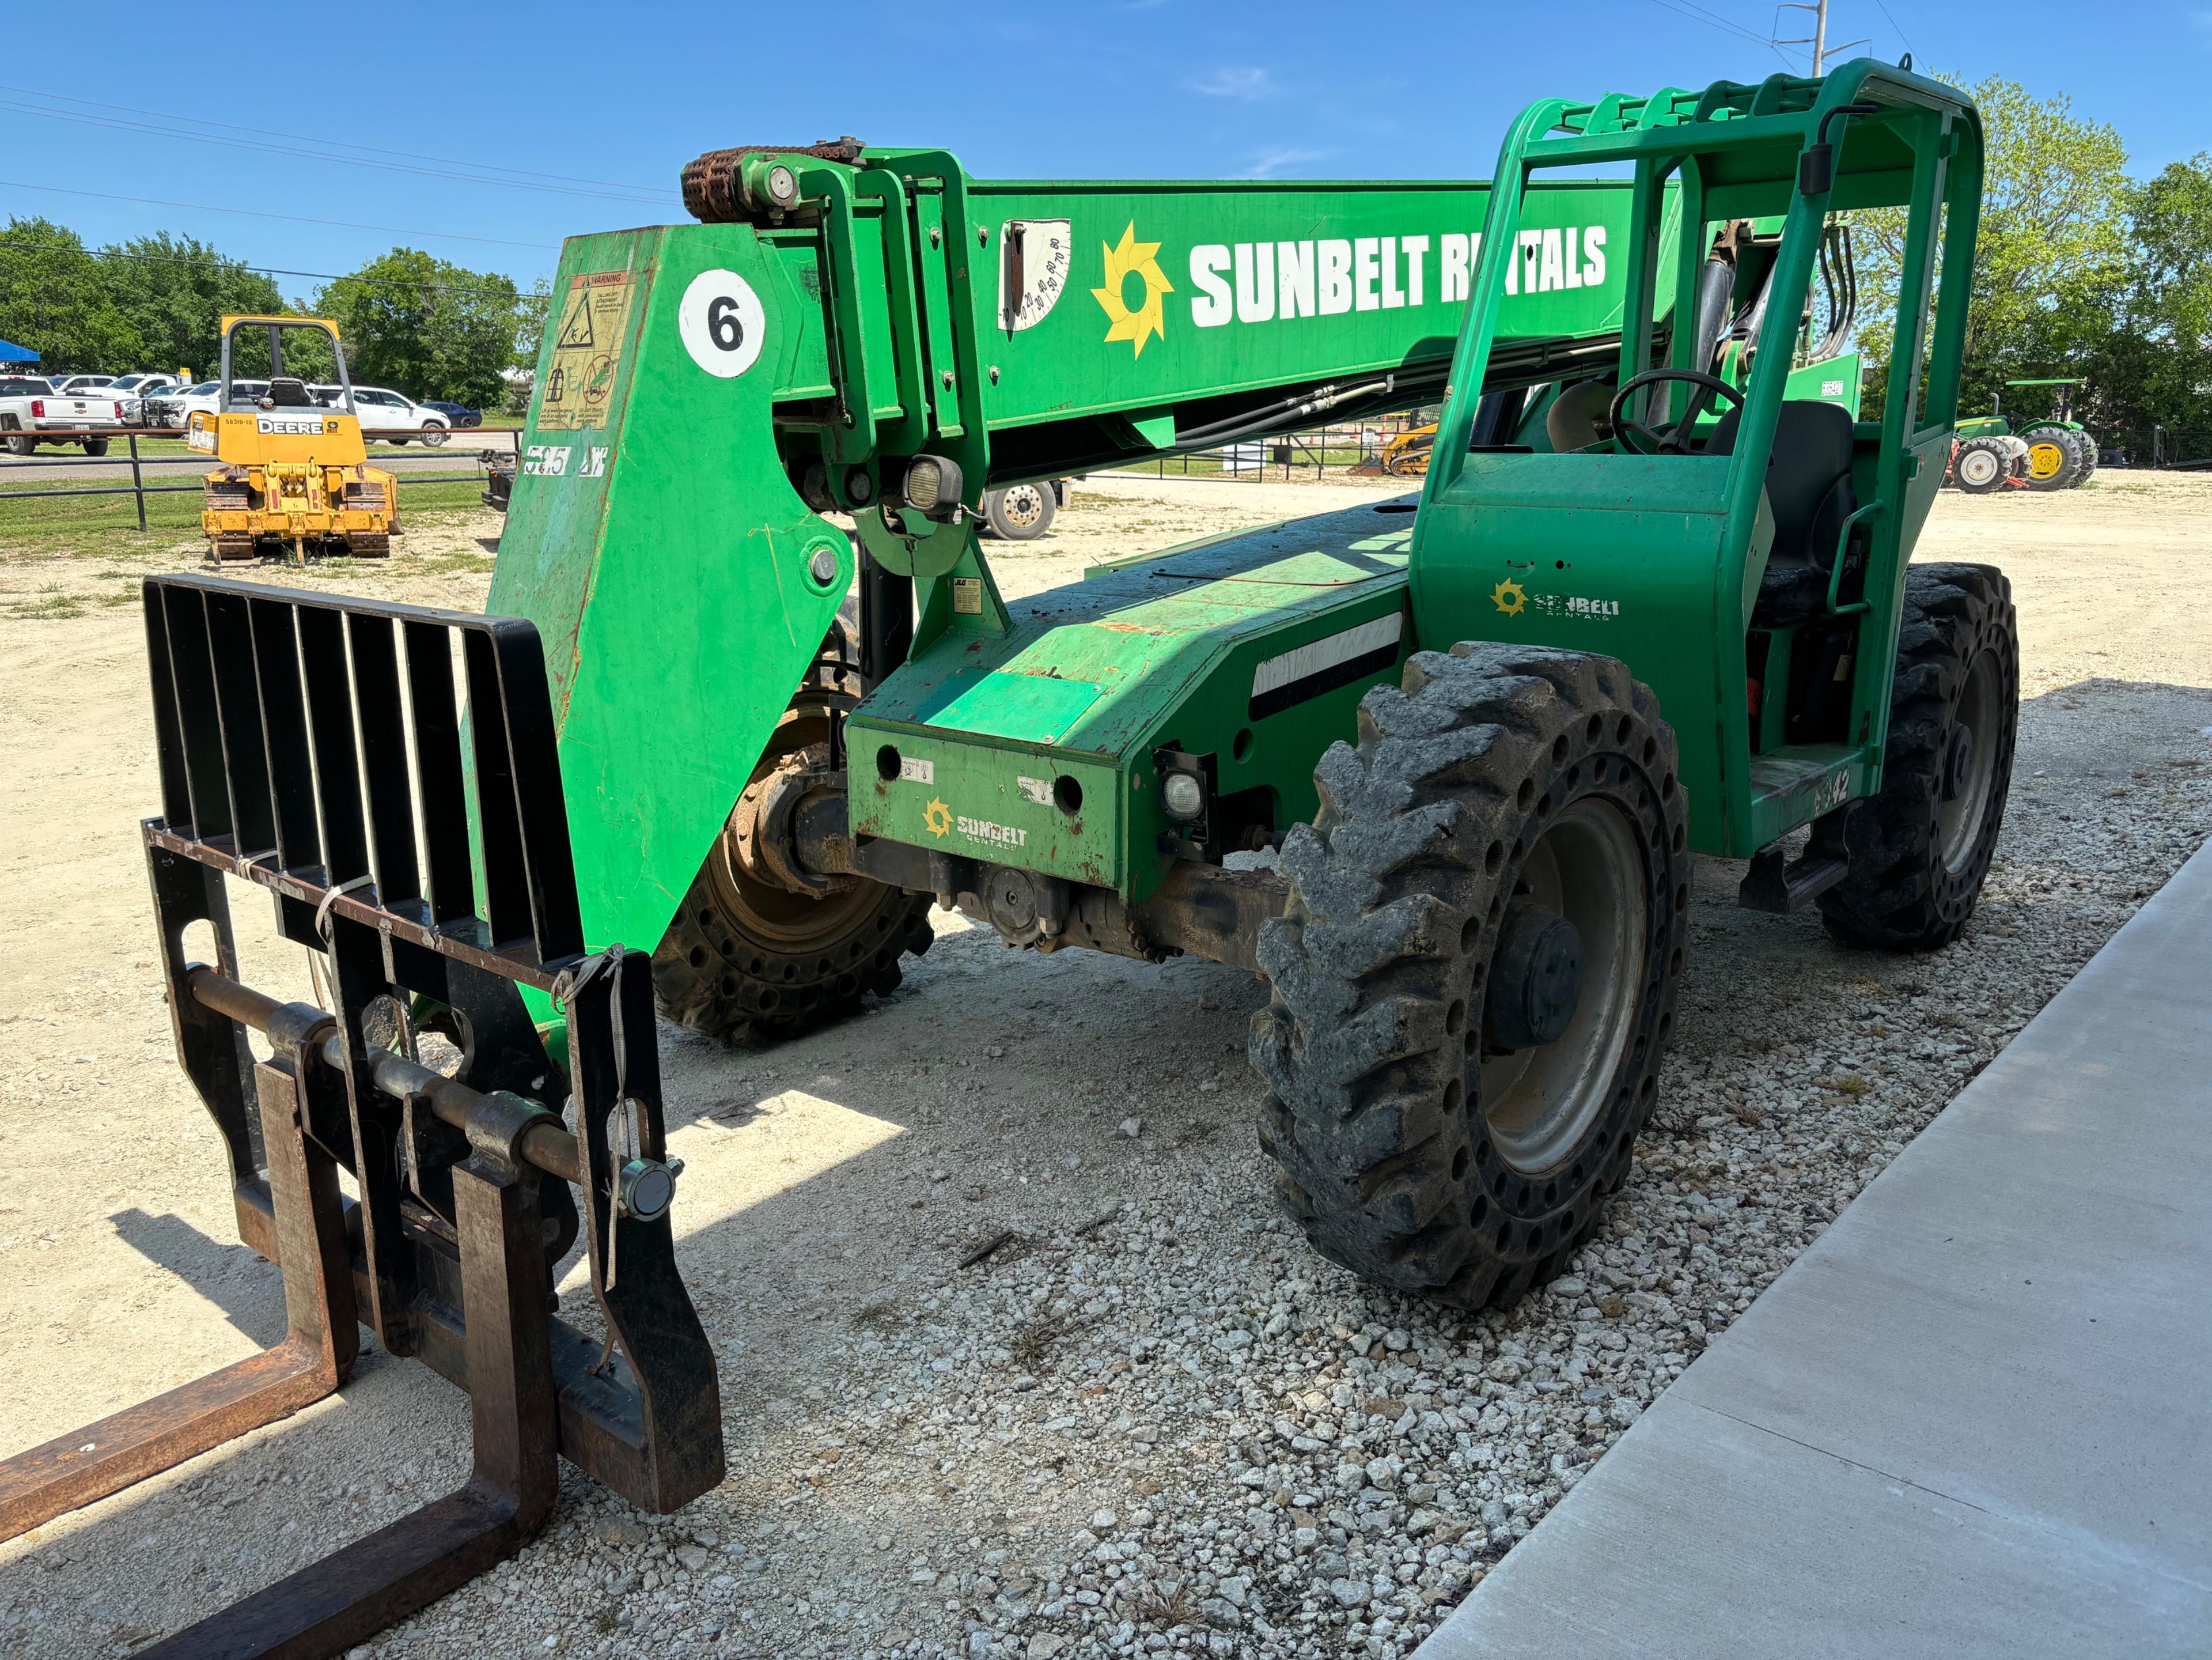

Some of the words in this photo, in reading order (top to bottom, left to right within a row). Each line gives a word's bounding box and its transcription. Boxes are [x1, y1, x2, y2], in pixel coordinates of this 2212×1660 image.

[1050, 238, 1059, 249] 80
[1055, 252, 1065, 264] 70
[1046, 260, 1056, 274] 60
[591, 274, 621, 284] WARNING
[1047, 277, 1057, 291] 50
[1189, 235, 1429, 328] SUNBELT
[1441, 225, 1607, 303] RNTALS
[1037, 279, 1047, 293] 40
[1024, 292, 1033, 308] 20
[1035, 295, 1044, 311] 30
[1020, 306, 1027, 321] 10
[707, 296, 744, 351] 6
[257, 419, 324, 436] DEERE
[957, 816, 1027, 846] SUNBELT
[967, 834, 1017, 852] RENTALS
